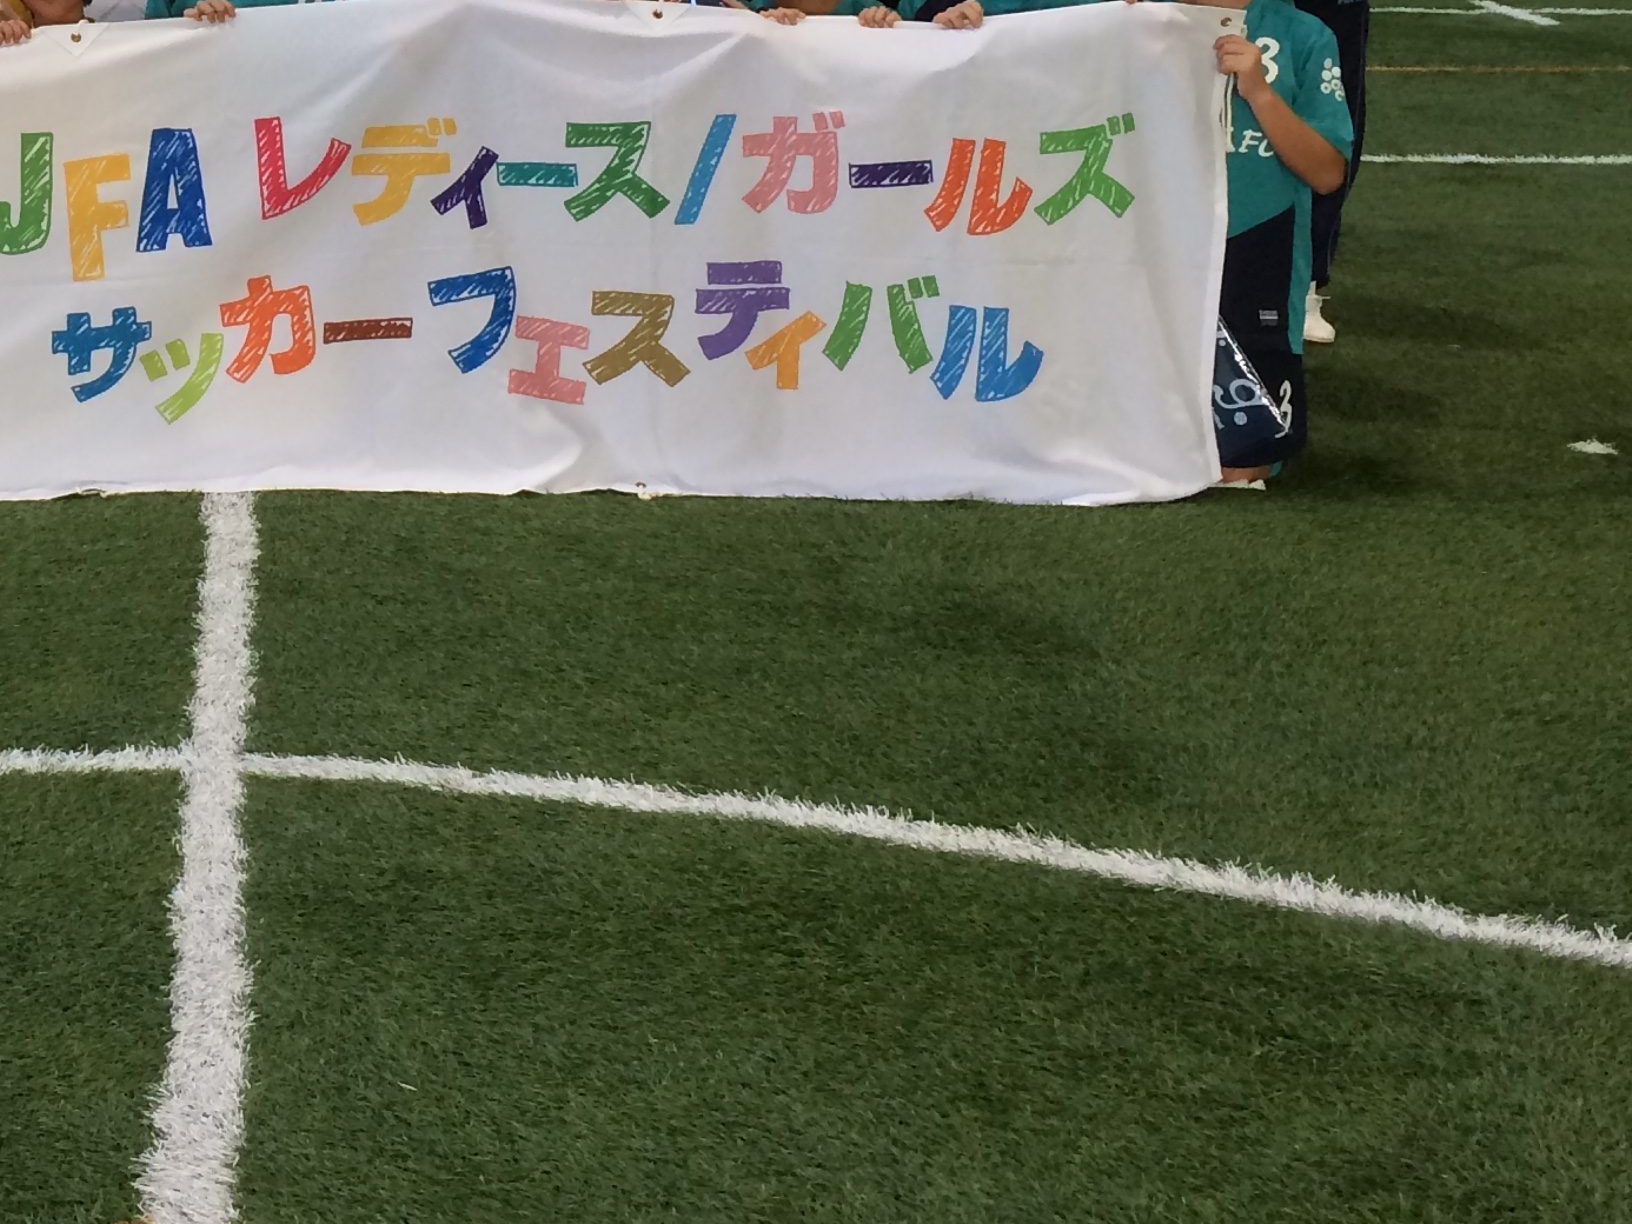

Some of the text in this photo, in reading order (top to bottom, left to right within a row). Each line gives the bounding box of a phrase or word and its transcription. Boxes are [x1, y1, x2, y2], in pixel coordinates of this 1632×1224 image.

[51, 260, 1044, 424] サッカーフェスティバル
